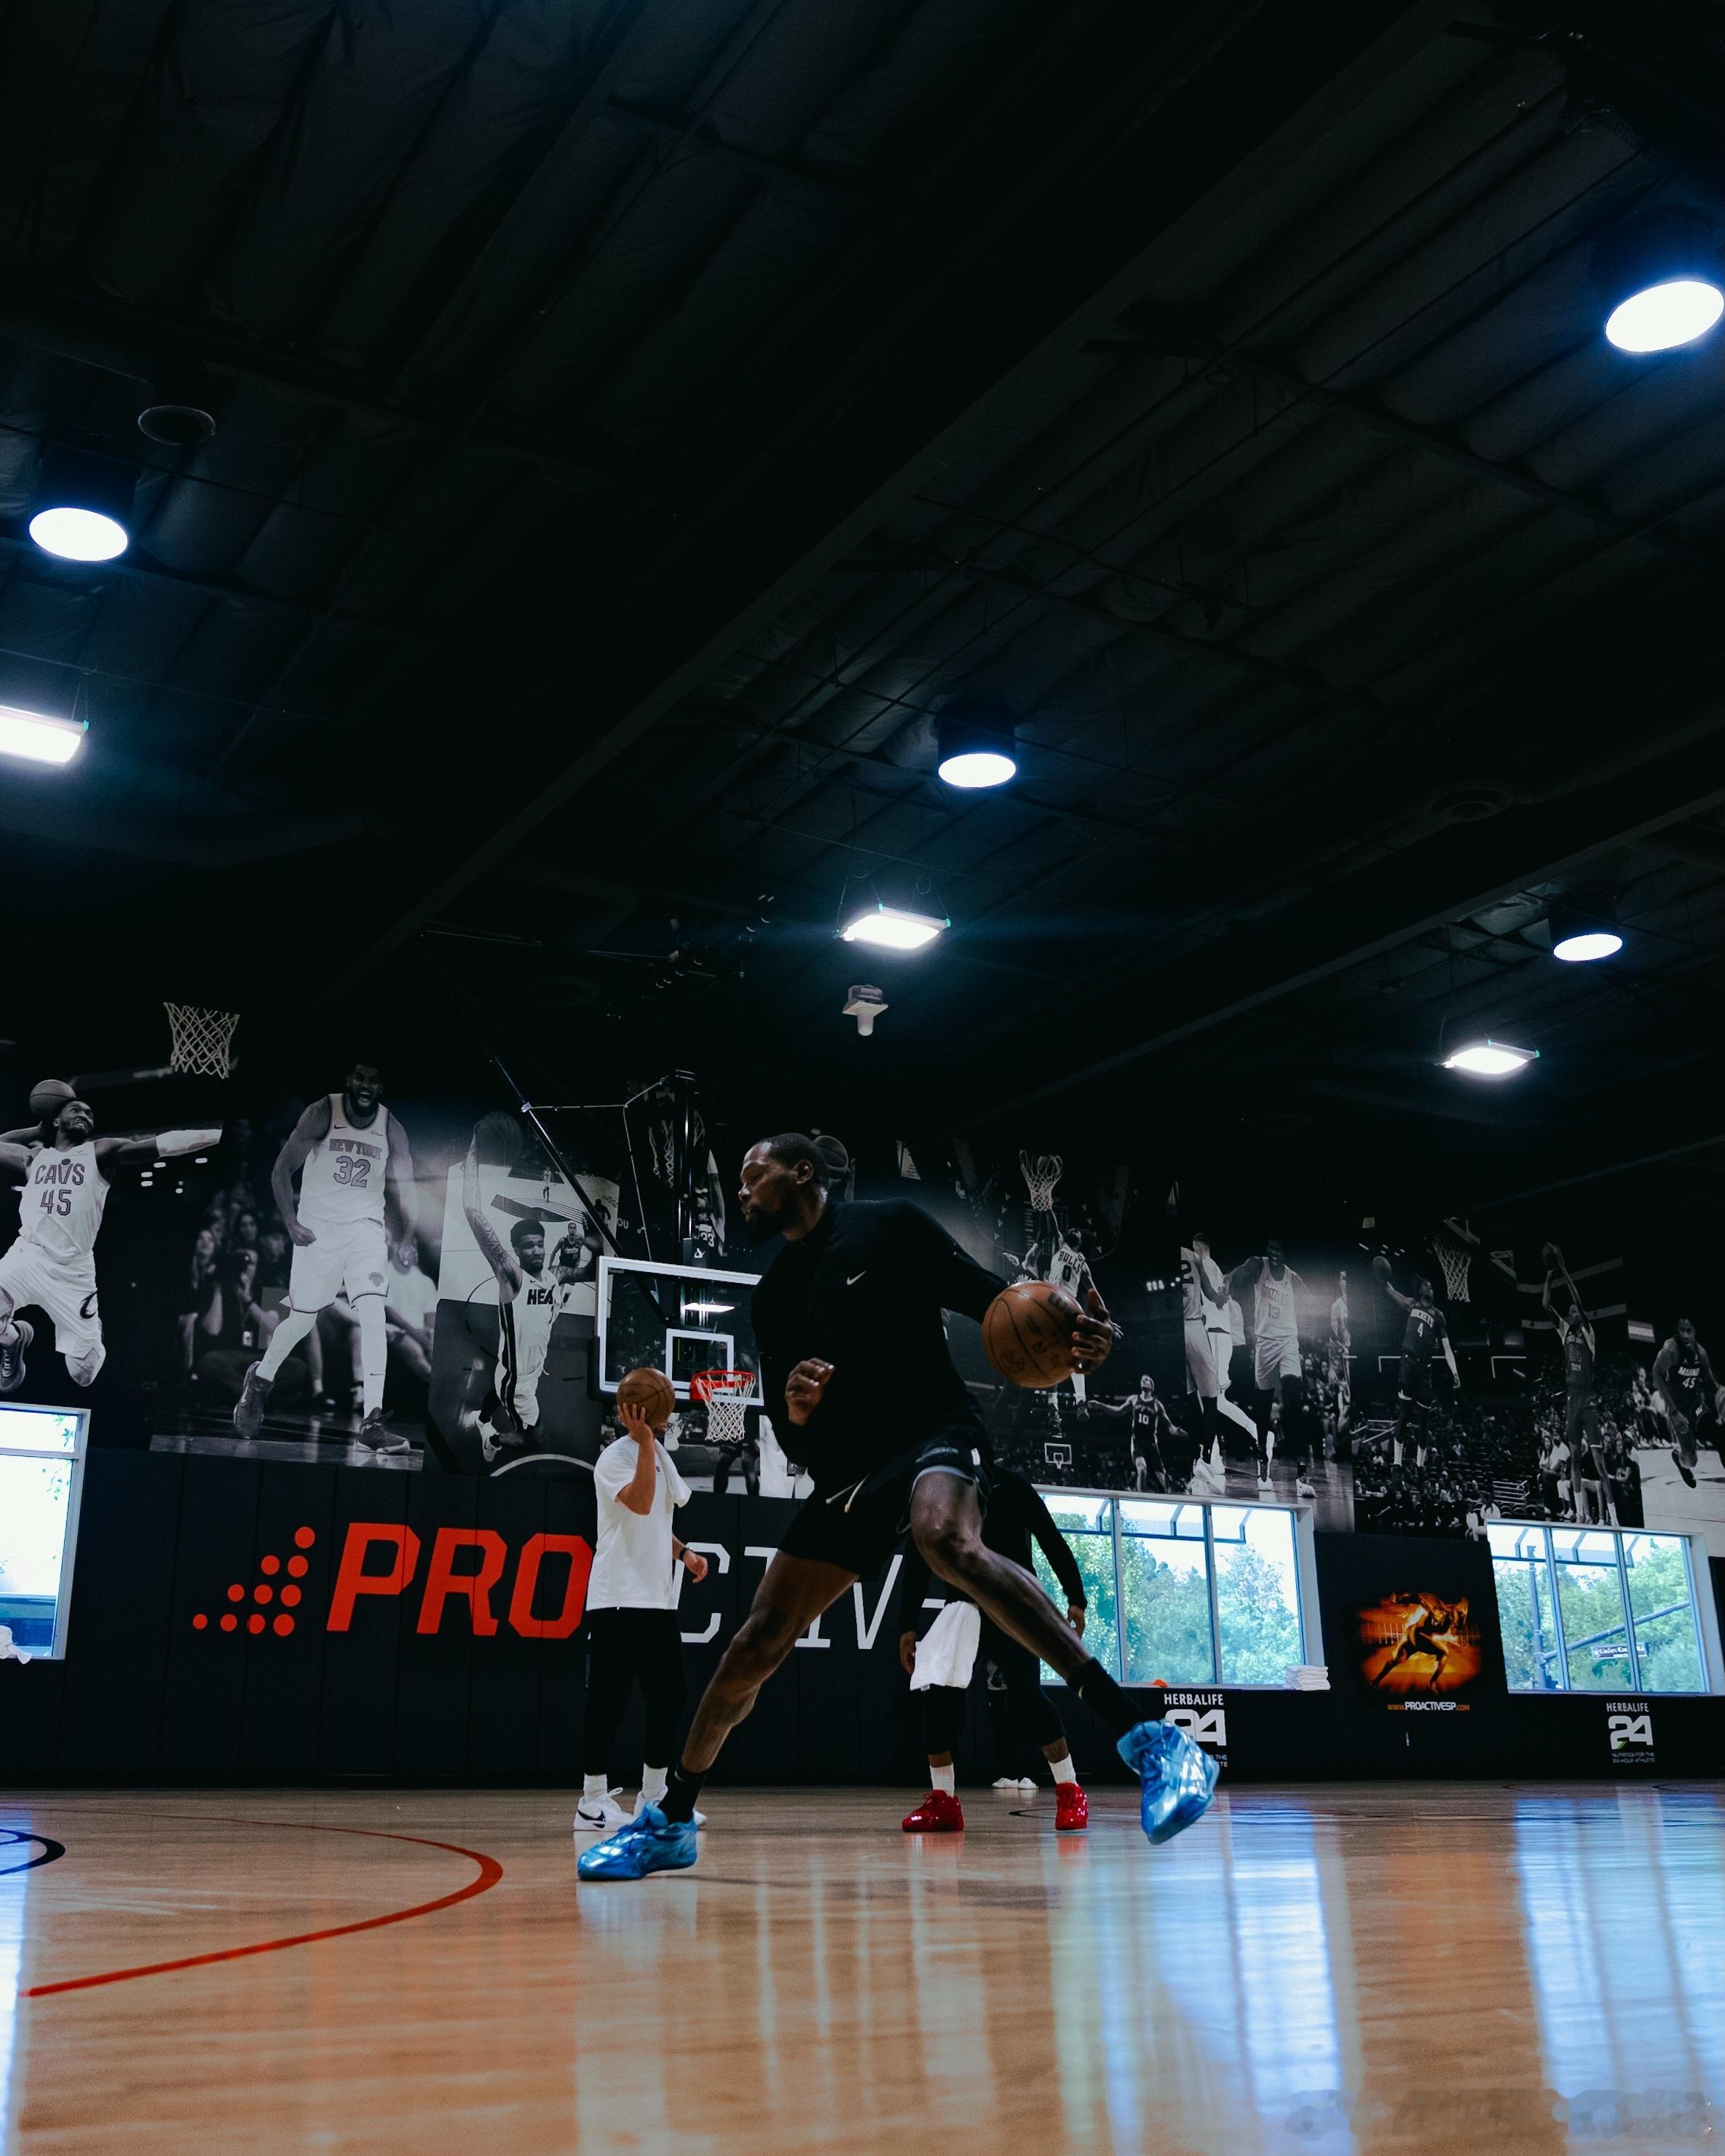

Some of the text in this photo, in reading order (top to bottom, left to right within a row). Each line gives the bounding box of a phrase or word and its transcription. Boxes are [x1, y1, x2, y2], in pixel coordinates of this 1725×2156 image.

[329, 1139, 383, 1161] NEW YORK
[34, 1158, 85, 1185] CAVS
[333, 1156, 371, 1188] 32
[40, 1189, 72, 1216] 45
[1058, 1251, 1083, 1274] BULLS
[1062, 1265, 1073, 1282] 0
[526, 1289, 556, 1306] HEA
[1417, 1322, 1424, 1338] 4
[1683, 1378, 1697, 1389] 45
[1138, 1413, 1149, 1425] 10
[1164, 1693, 1224, 1705] HERBALIFE
[1606, 1702, 1649, 1712] HERBALIFE
[1608, 1715, 1654, 1750] 24
